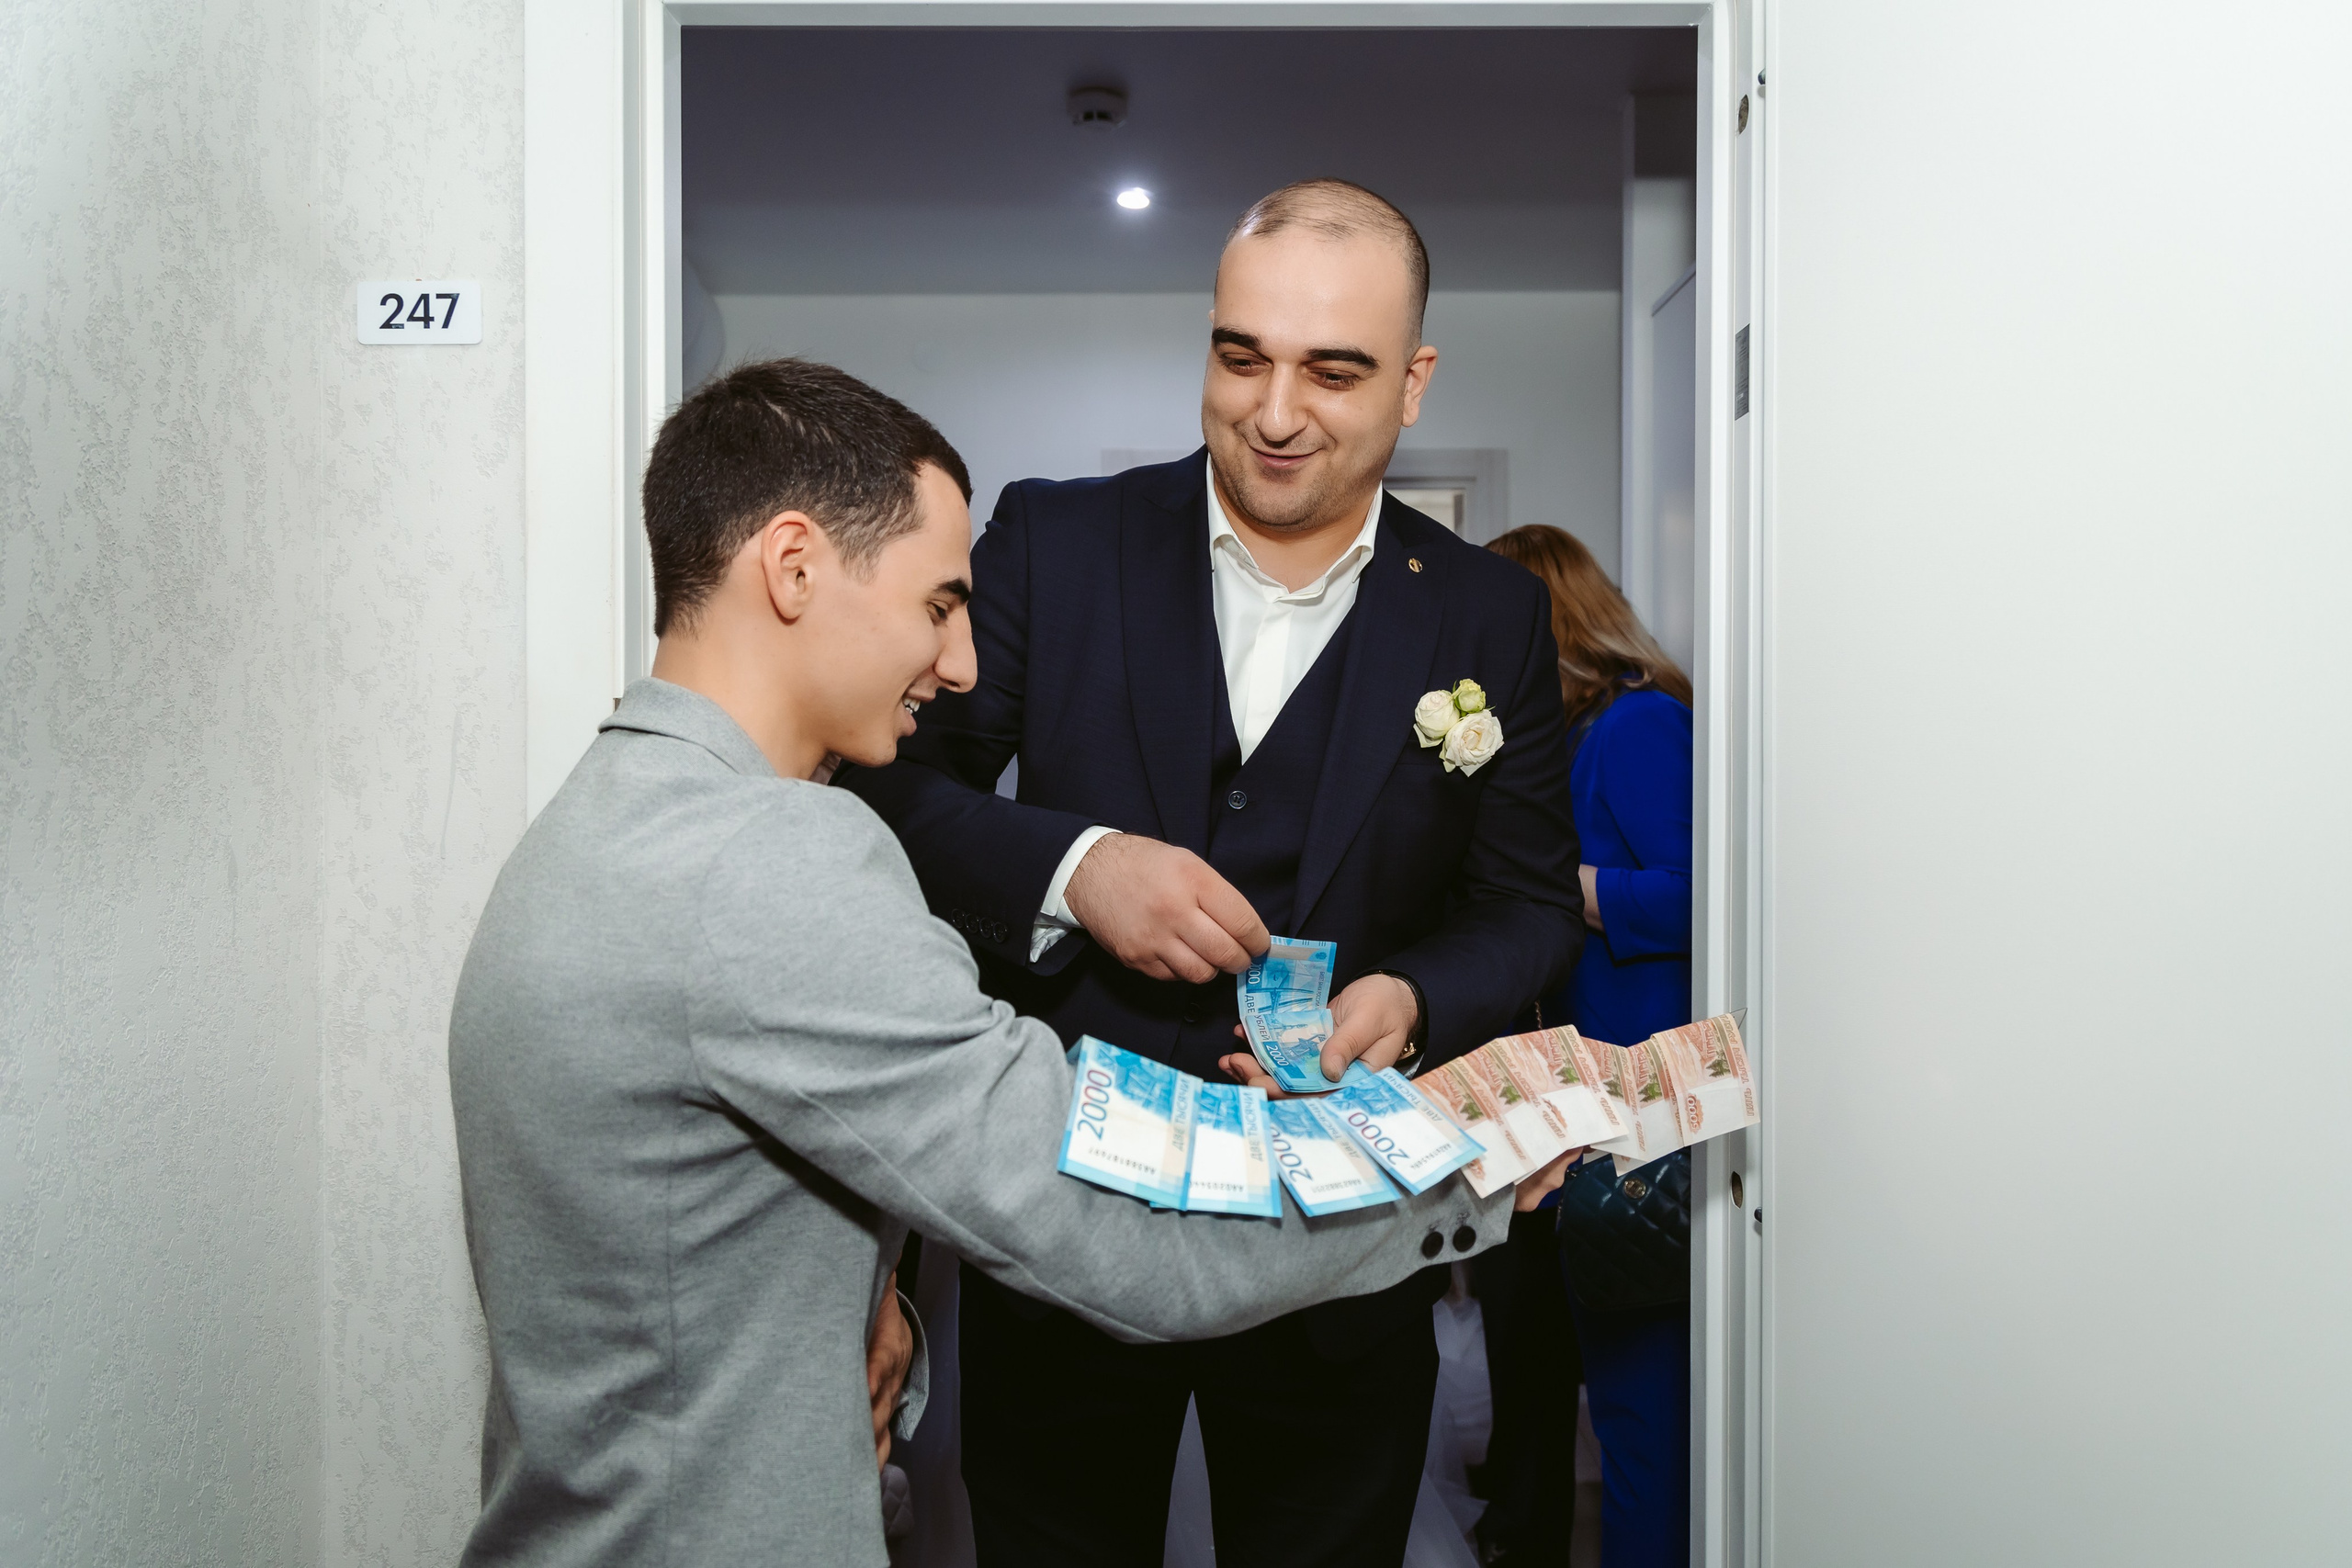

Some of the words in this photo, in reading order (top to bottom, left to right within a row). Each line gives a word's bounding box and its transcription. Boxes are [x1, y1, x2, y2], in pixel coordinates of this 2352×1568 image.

[379, 292, 459, 329] 247
[1245, 994, 1256, 1014] ДВЕ
[1254, 1014, 1271, 1041] УБЛЕЙ
[1266, 1044, 1290, 1066] 2000
[1734, 1048, 1749, 1085] ТЫСЯЧ
[1383, 1072, 1421, 1106] ТЫСЯЧИ
[1580, 1057, 1601, 1094] ТЫСЯЧ
[1077, 1069, 1112, 1140] 2000
[1176, 1078, 1192, 1125] ТЫСЯЧИ
[1242, 1089, 1259, 1133] ТЫСЯЧИ
[1423, 1105, 1443, 1122] ДВЕ
[1686, 1096, 1699, 1130] 5000
[1308, 1102, 1340, 1139] ТЫСЯЧИ
[1172, 1126, 1185, 1152] ДВЕ
[1250, 1132, 1264, 1162] ДВЕ
[1340, 1140, 1361, 1159] ДВЕ
[1348, 1111, 1409, 1165] 2000
